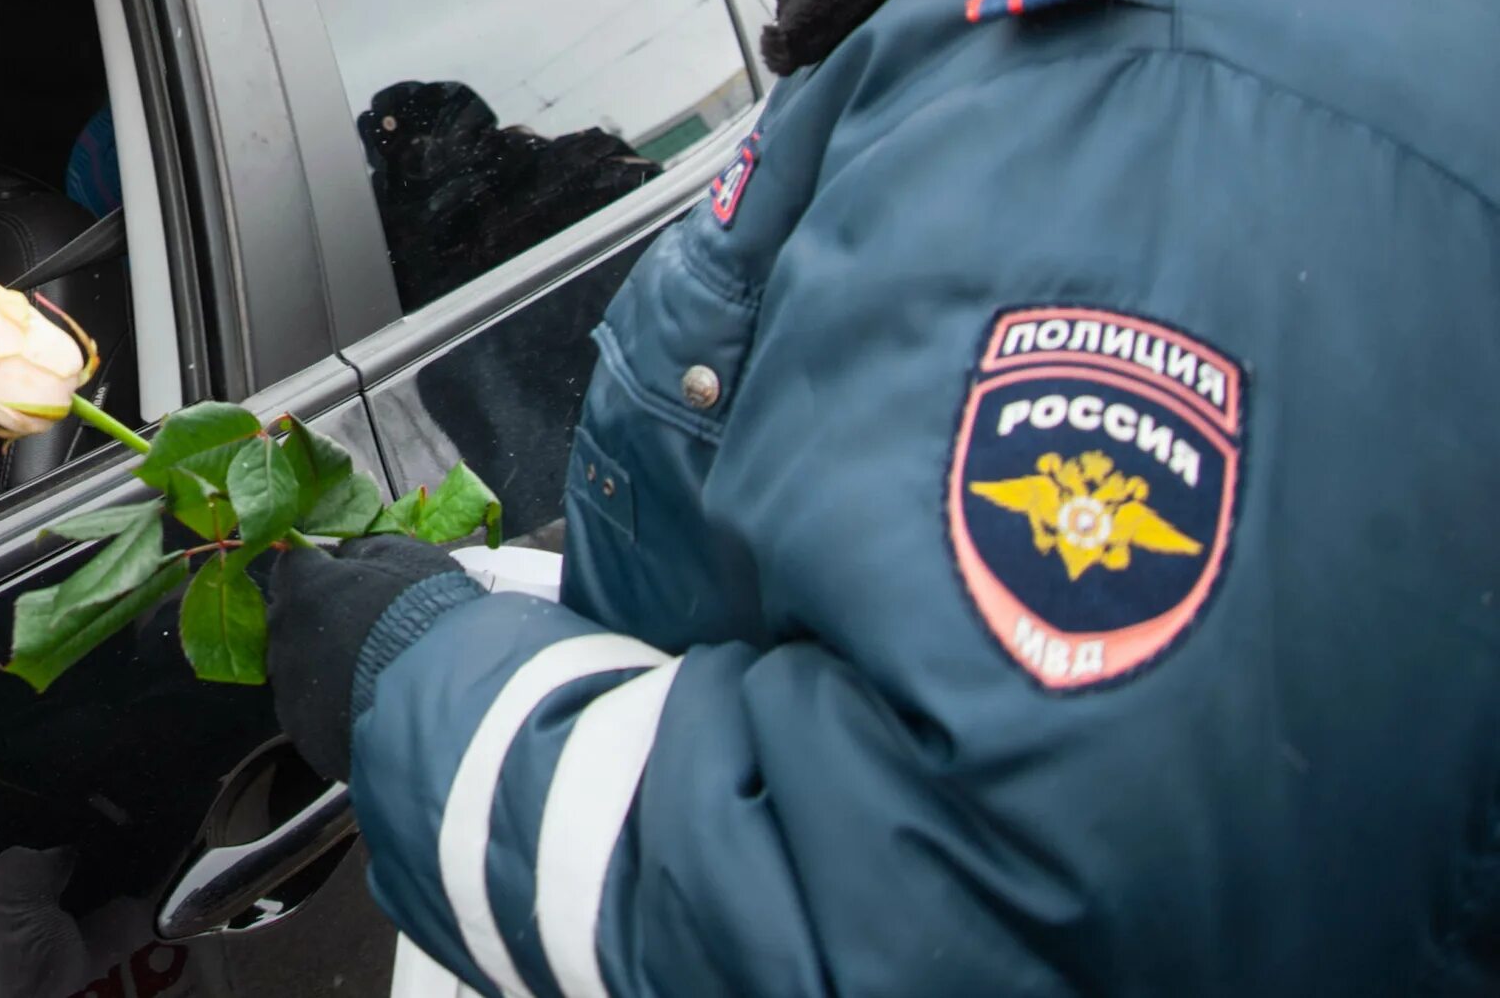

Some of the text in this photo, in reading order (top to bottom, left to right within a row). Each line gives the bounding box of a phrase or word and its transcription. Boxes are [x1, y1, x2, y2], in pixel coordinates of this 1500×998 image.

[1003, 320, 1226, 406] ПОЛИЦИЯ
[997, 394, 1202, 488] РОССИЯ
[1013, 616, 1105, 678] МВД
